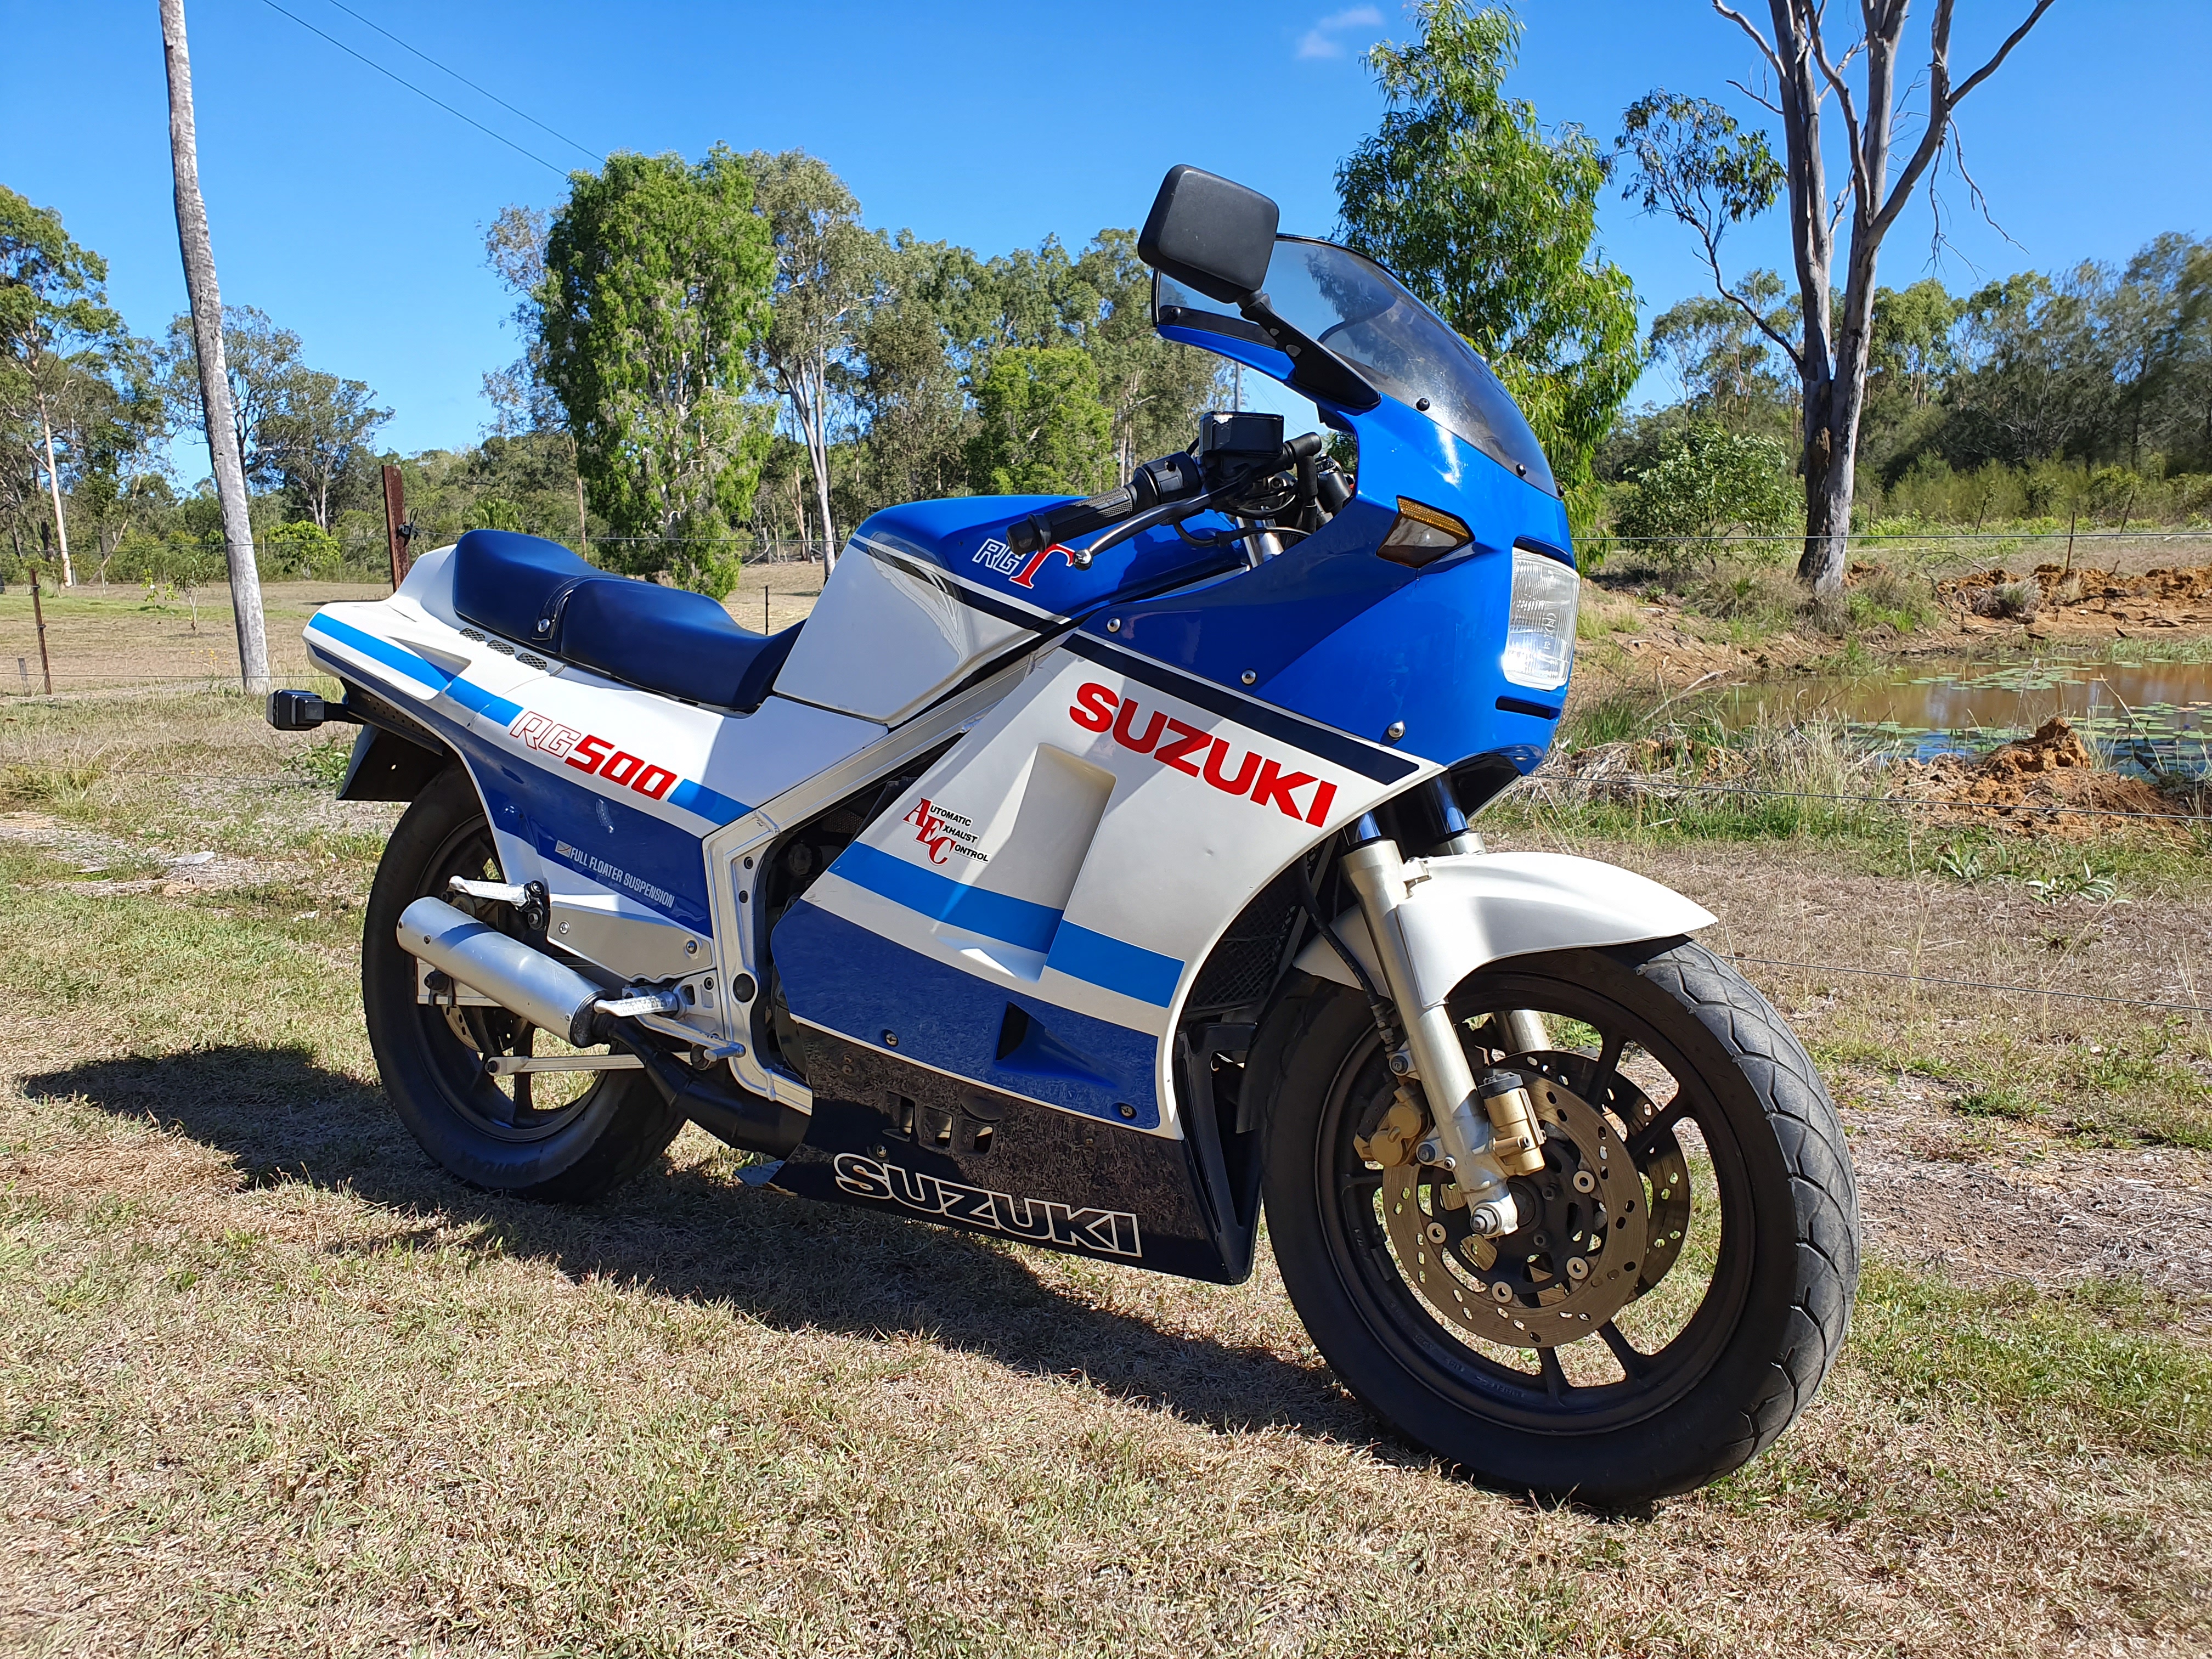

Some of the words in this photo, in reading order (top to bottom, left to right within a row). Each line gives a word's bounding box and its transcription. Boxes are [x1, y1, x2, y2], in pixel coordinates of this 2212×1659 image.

[509, 711, 678, 800] RG500
[1069, 682, 1338, 828] SUZUKI
[570, 847, 587, 866] FULL
[589, 856, 623, 883] FLOATER
[623, 873, 675, 908] SUSPENSION
[833, 1153, 1142, 1257] SUZUKI
